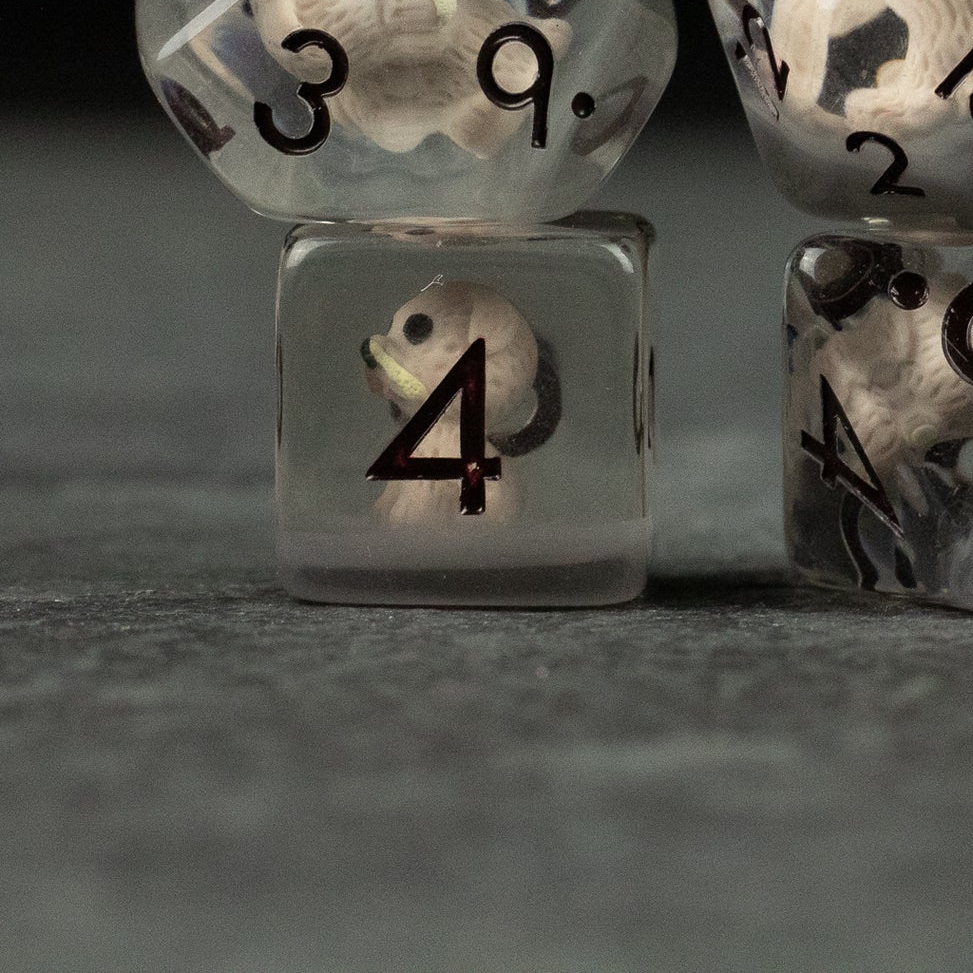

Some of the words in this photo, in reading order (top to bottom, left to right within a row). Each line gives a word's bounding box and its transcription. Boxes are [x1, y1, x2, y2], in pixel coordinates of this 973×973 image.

[253, 28, 350, 157] 3
[845, 130, 926, 198] 2
[366, 337, 502, 515] 4
